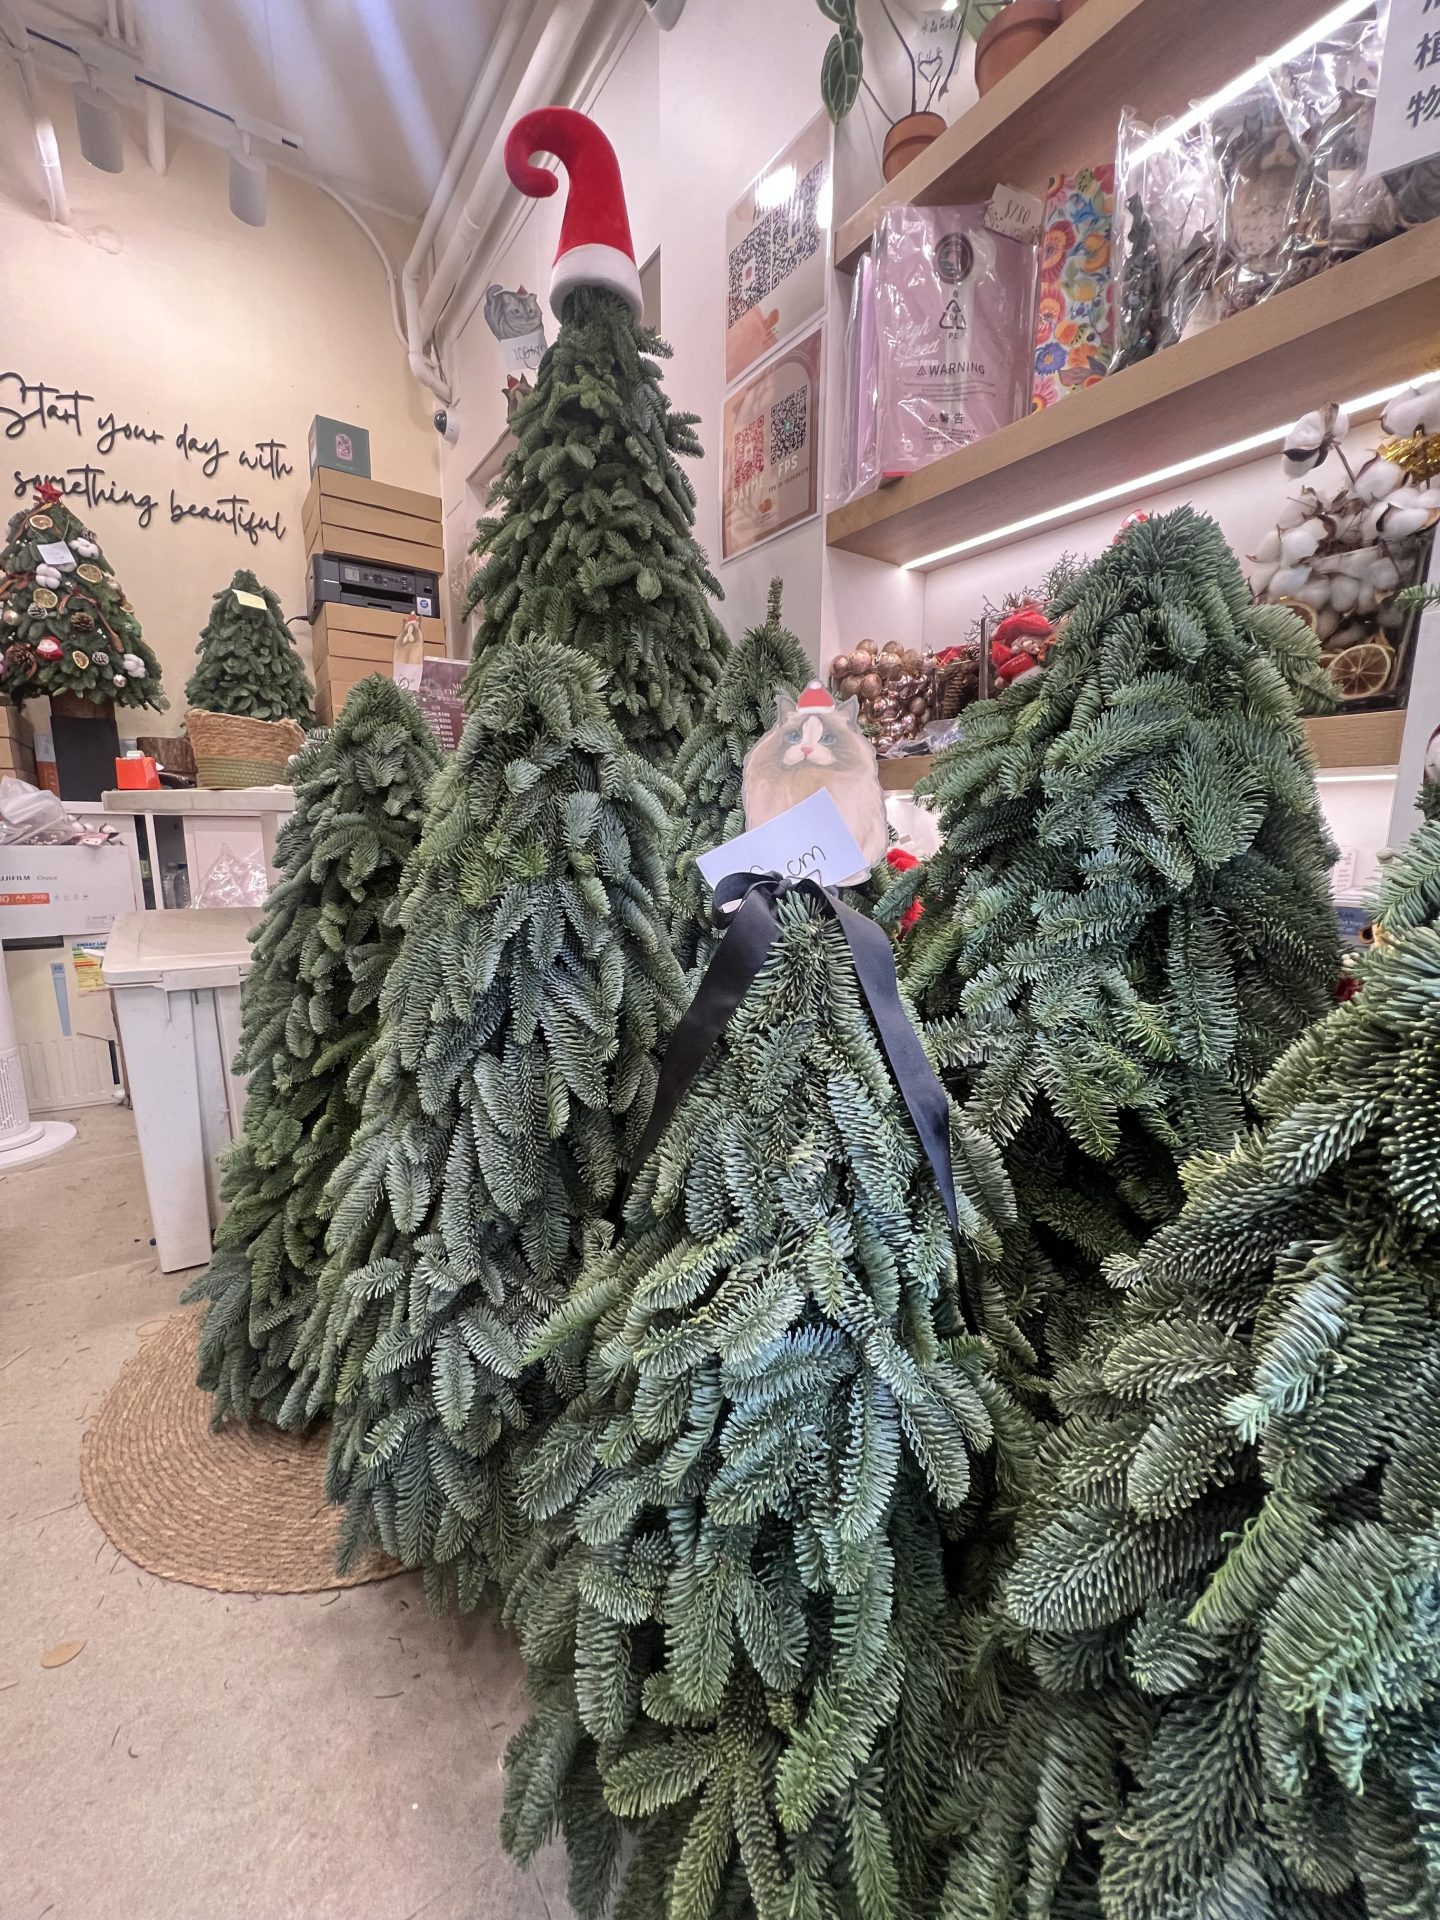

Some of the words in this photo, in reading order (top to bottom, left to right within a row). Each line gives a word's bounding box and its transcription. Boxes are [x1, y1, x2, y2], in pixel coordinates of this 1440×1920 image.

[948, 332, 959, 340] PE
[929, 360, 985, 377] WARNING
[0, 371, 95, 438] Start
[96, 413, 164, 455] your
[176, 423, 229, 477] day
[239, 439, 293, 480] with
[778, 454, 798, 478] FPS
[170, 489, 287, 545] beautiful
